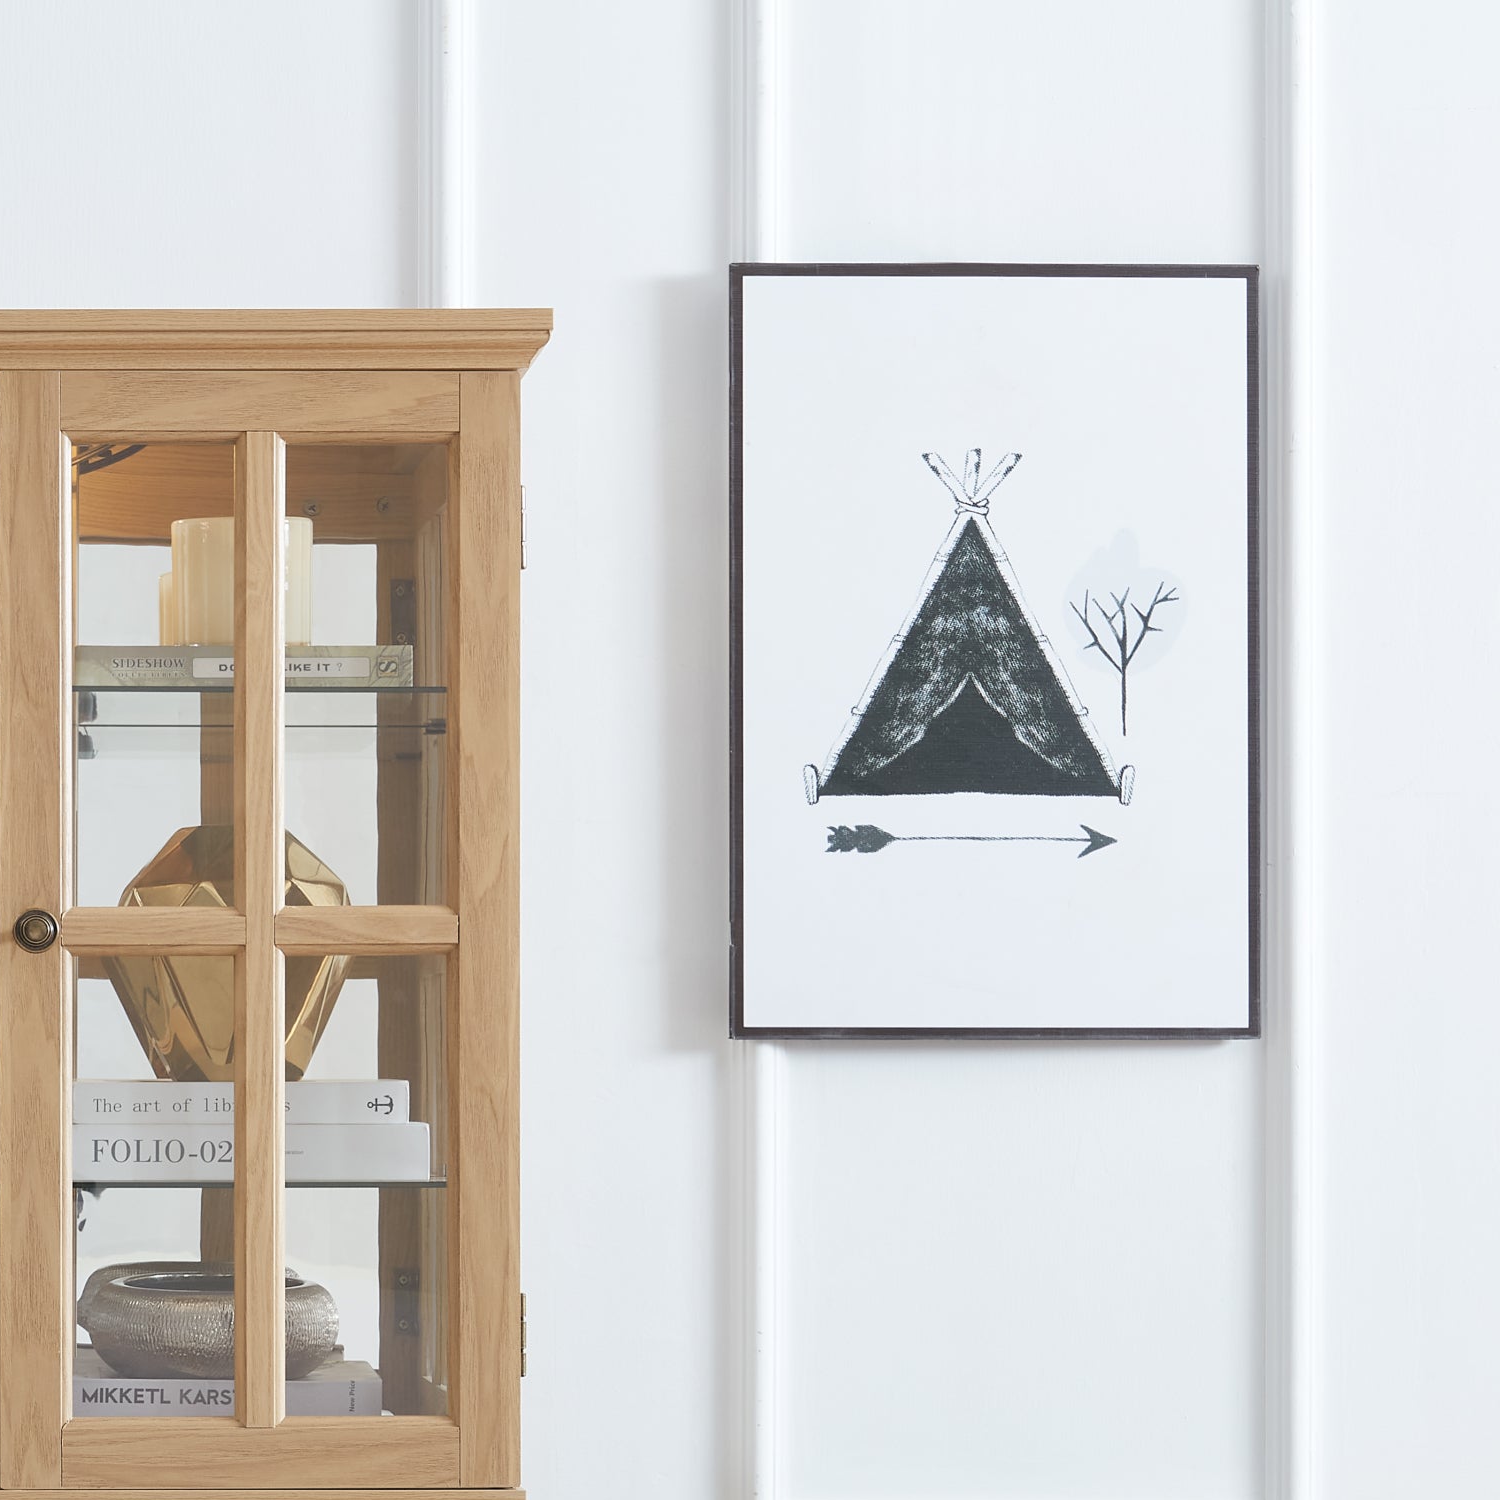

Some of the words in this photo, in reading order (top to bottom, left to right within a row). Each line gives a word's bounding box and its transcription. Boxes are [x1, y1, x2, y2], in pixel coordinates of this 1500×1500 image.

[112, 658, 186, 669] SIDESHOW
[316, 663, 331, 672] IT
[93, 1098, 122, 1113] The
[132, 1099, 161, 1113] art
[172, 1098, 192, 1113] of
[91, 1138, 233, 1163] FOLIO-02
[82, 1387, 171, 1404] MIKKETL
[179, 1388, 235, 1405] KARS
